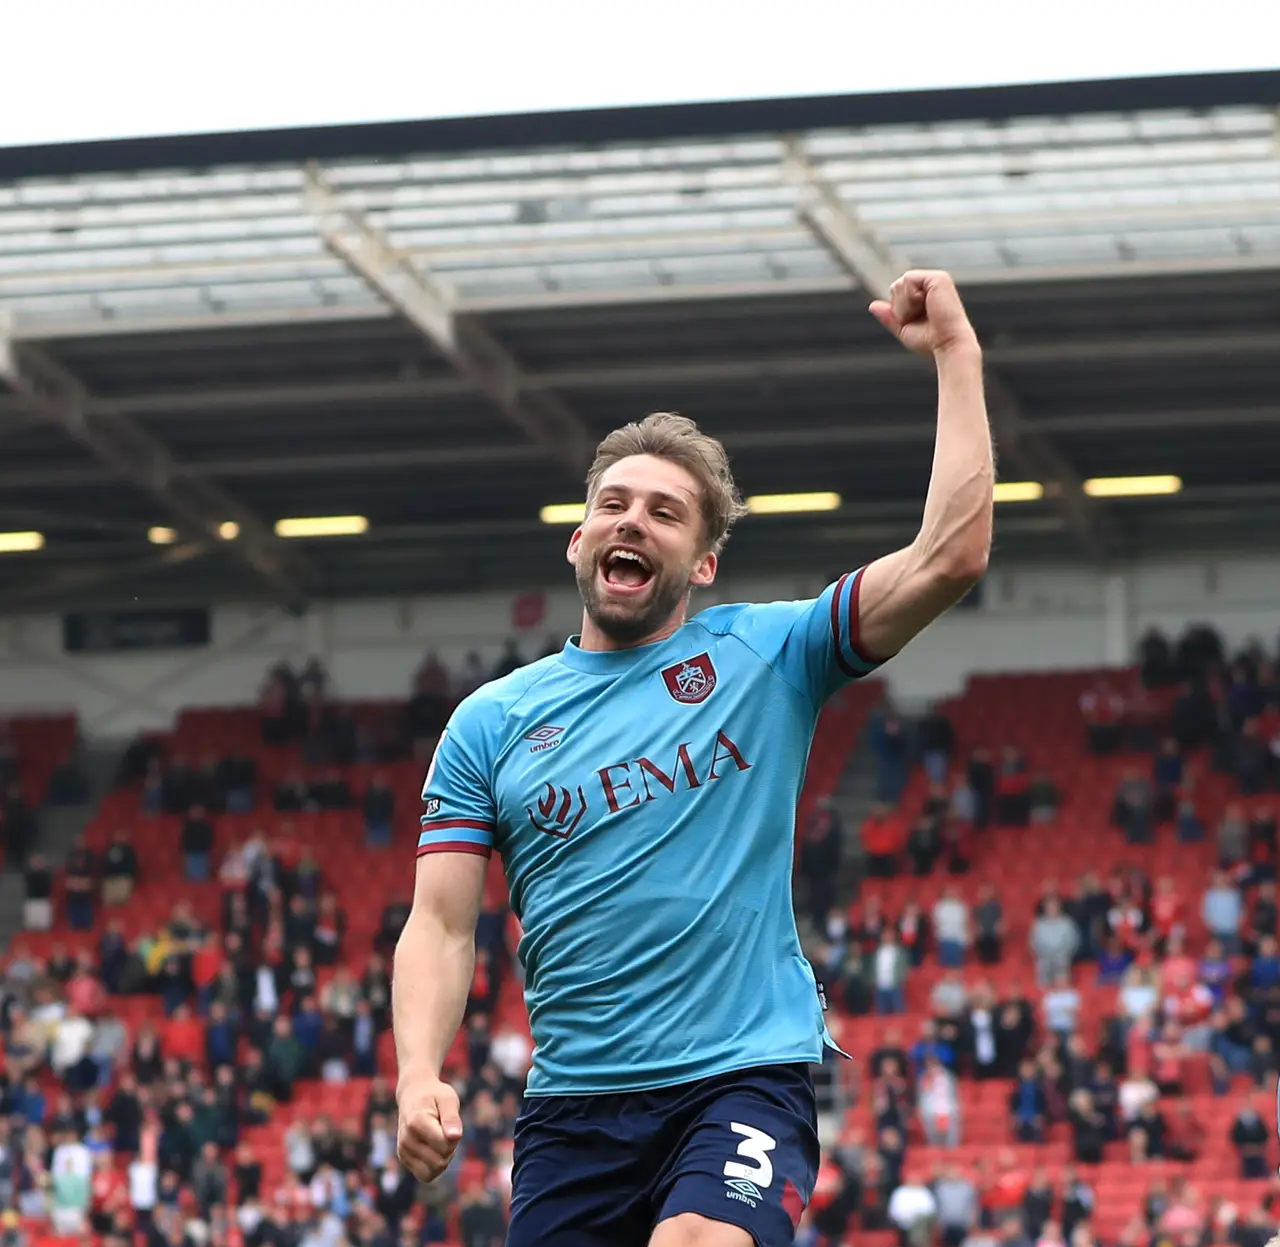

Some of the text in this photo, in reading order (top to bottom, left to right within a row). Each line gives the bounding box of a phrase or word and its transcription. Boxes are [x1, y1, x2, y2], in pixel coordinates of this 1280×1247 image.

[529, 740, 560, 753] umbro
[597, 729, 753, 814] EMA
[723, 1121, 776, 1188] 3
[726, 1191, 757, 1208] umbro
